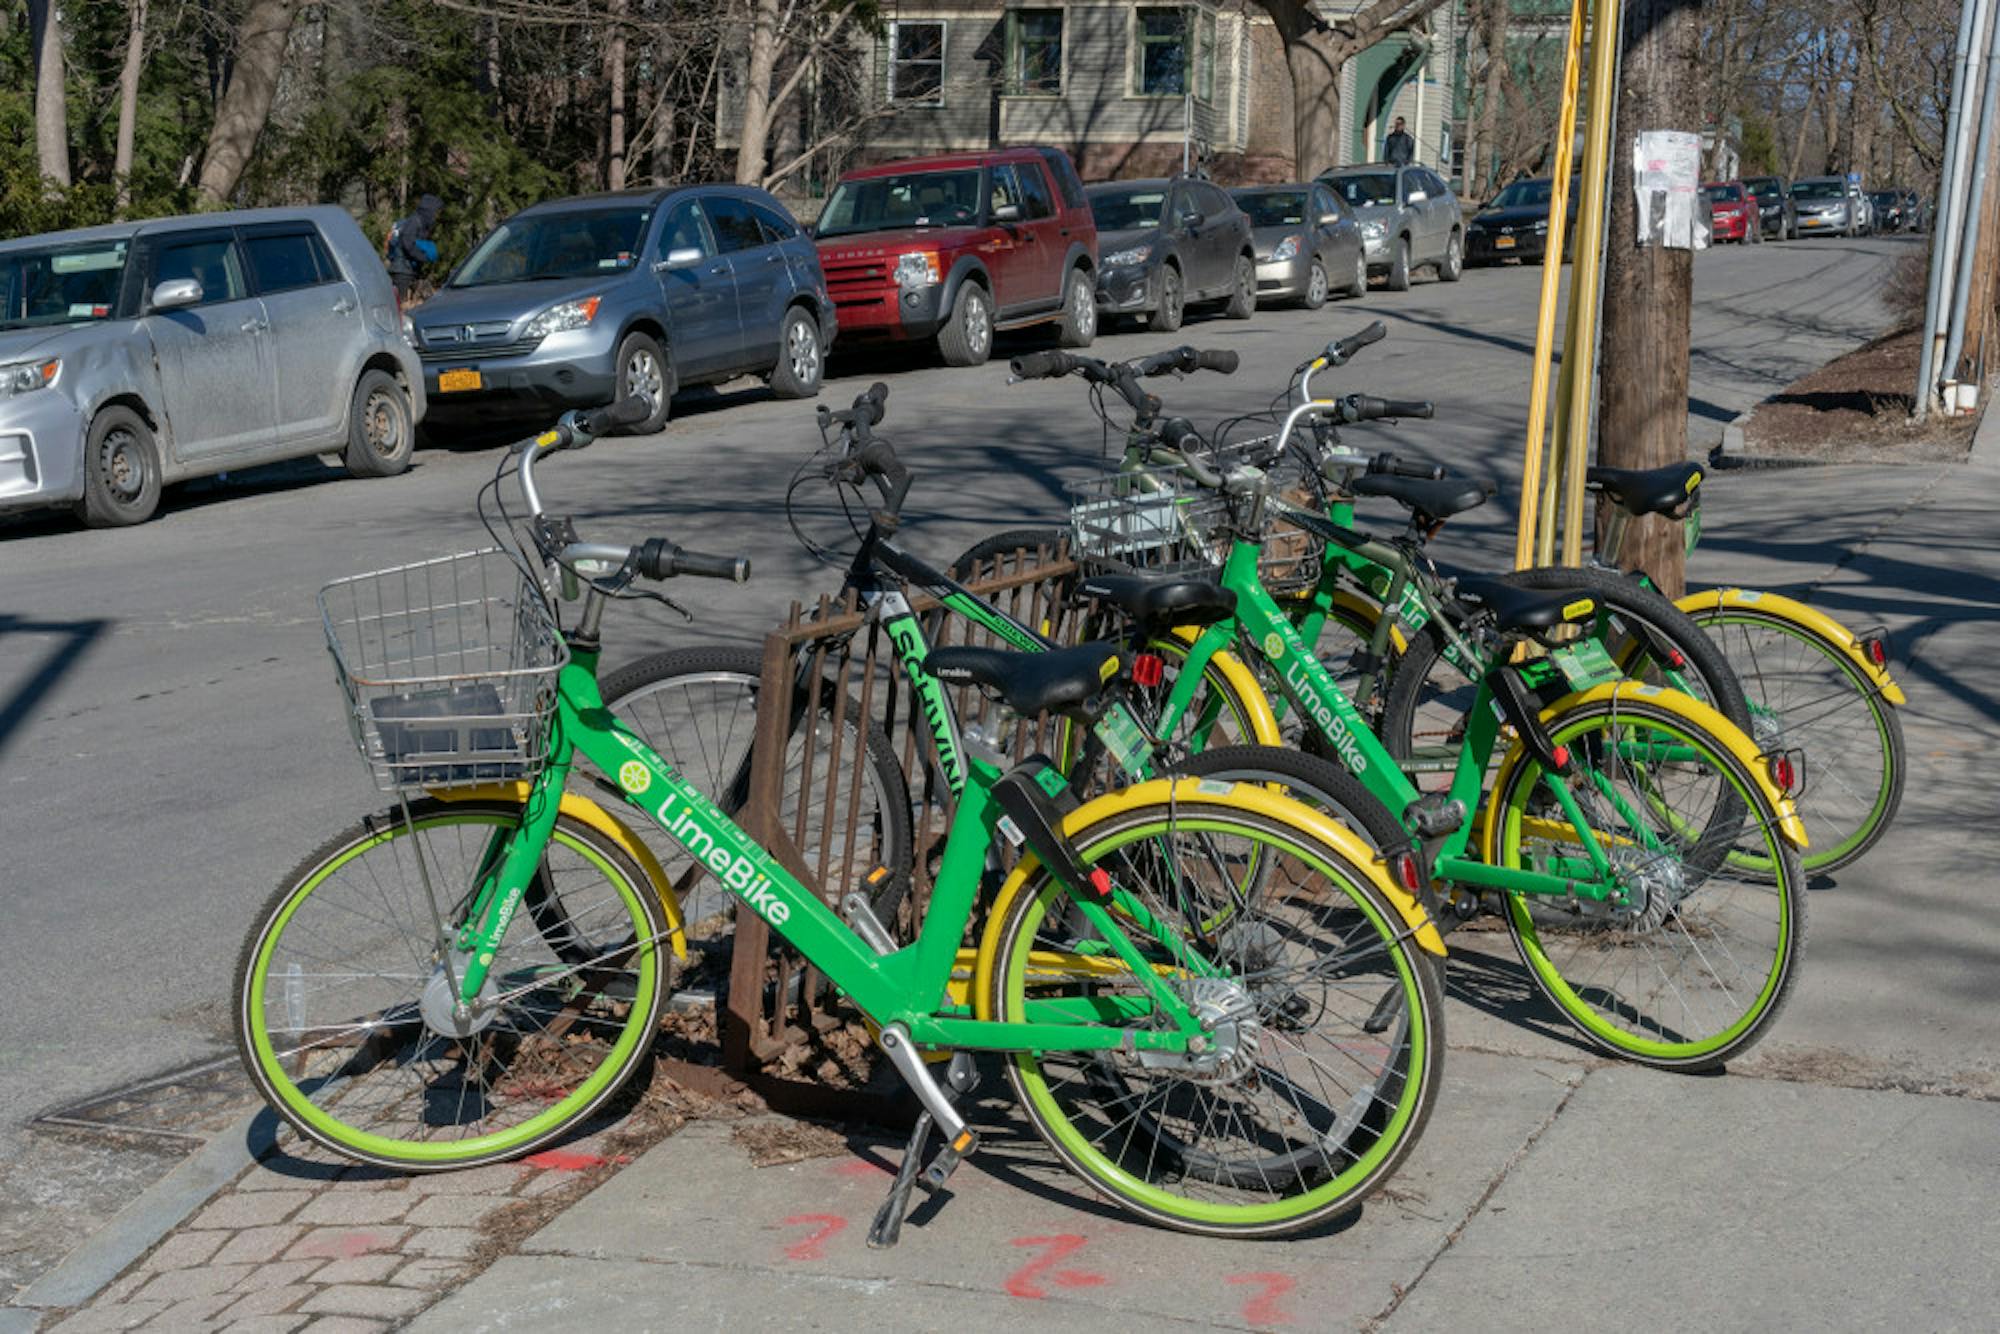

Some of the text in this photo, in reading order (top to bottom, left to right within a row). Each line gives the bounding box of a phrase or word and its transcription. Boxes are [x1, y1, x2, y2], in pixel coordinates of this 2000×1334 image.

[1287, 661, 1367, 773] LimeBike
[657, 793, 790, 926] LimeBike
[486, 887, 521, 948] LimeBike
